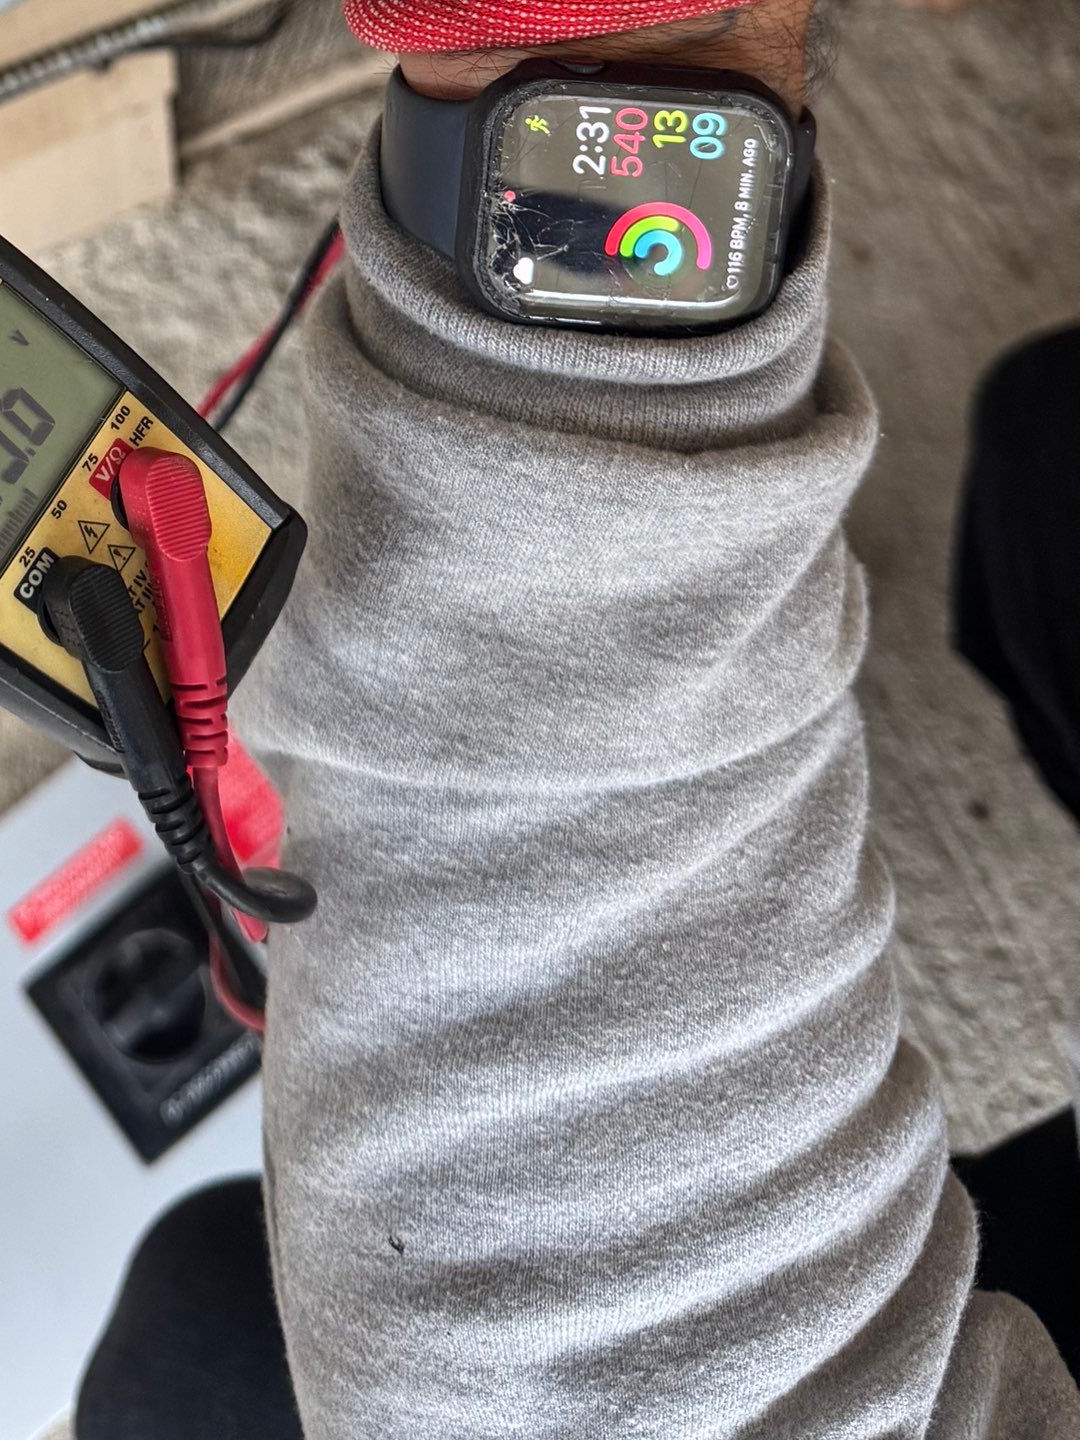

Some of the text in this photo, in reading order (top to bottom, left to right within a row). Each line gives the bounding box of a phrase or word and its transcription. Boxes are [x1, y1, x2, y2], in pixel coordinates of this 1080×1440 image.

[573, 106, 611, 175] 2:31
[611, 108, 648, 177] 540
[653, 110, 688, 148] 13
[690, 113, 727, 159] 09
[727, 252, 742, 275] 116
[735, 201, 748, 211] 8
[742, 138, 759, 167] AGO
[129, 415, 154, 447] HFR
[19, 547, 36, 568] 25
[51, 499, 67, 520] 50
[82, 453, 99, 473] 75
[110, 405, 131, 431] 100
[19, 552, 55, 599] COM
